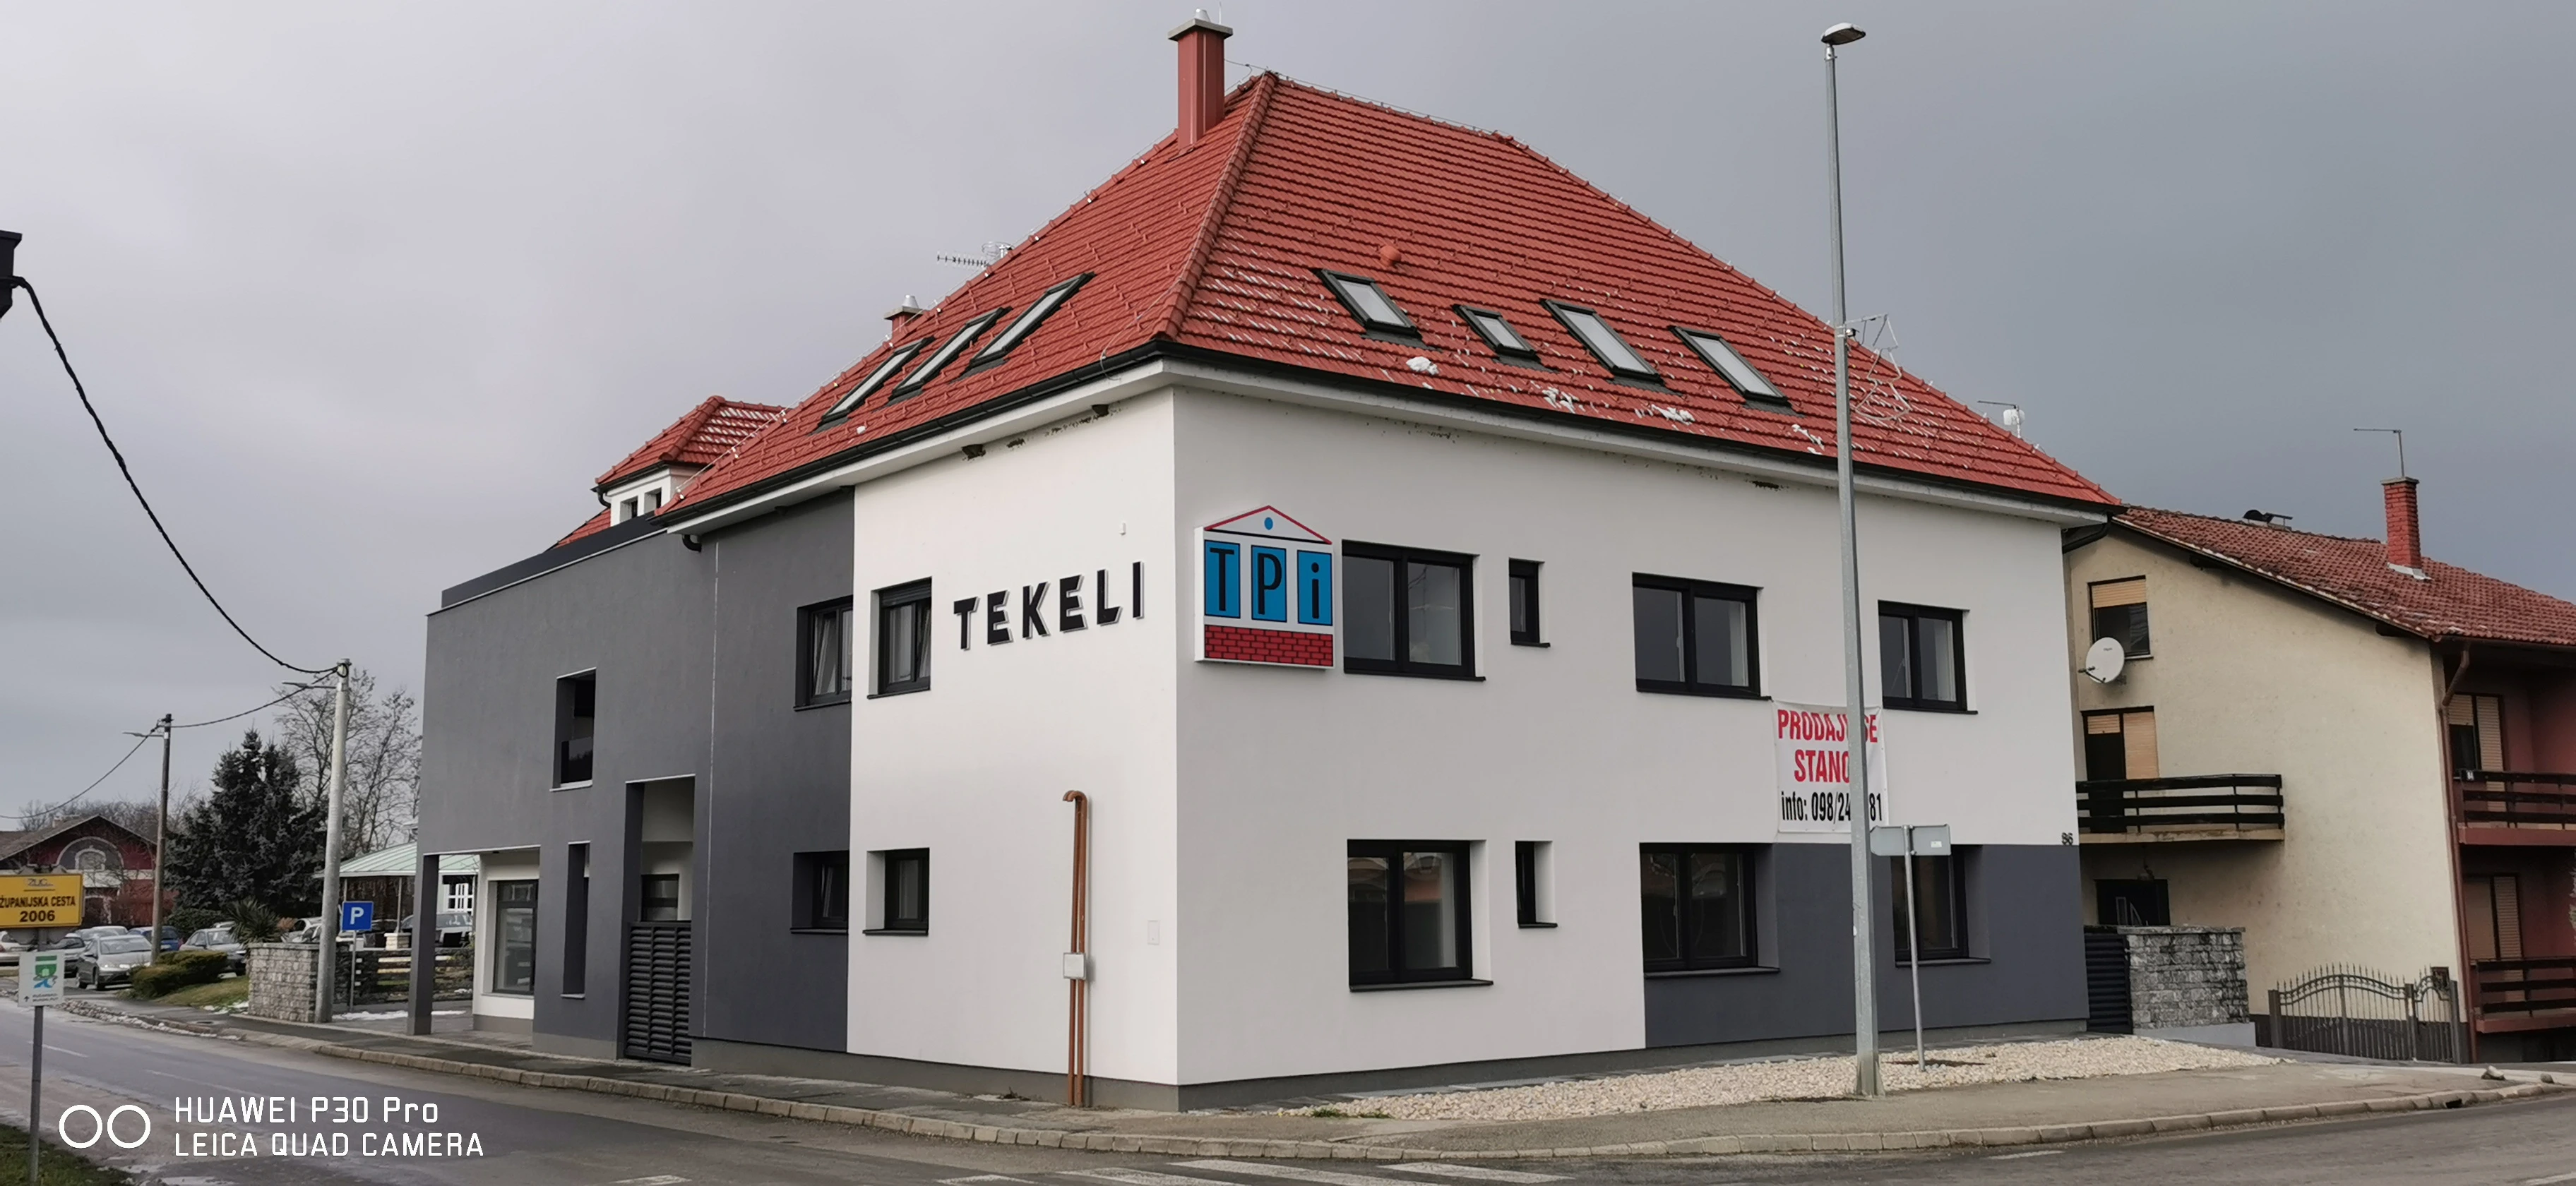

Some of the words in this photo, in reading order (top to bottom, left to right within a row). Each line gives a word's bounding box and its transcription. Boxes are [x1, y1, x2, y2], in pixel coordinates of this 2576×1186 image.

[953, 561, 1145, 651] TEKELI
[1794, 749, 1850, 784] STANO
[1781, 791, 1808, 821] info:
[1811, 791, 1883, 825] 098/2481
[2061, 832, 2074, 846] 86
[51, 896, 76, 907] CESTA
[19, 909, 56, 923] 2006
[350, 906, 364, 925] P
